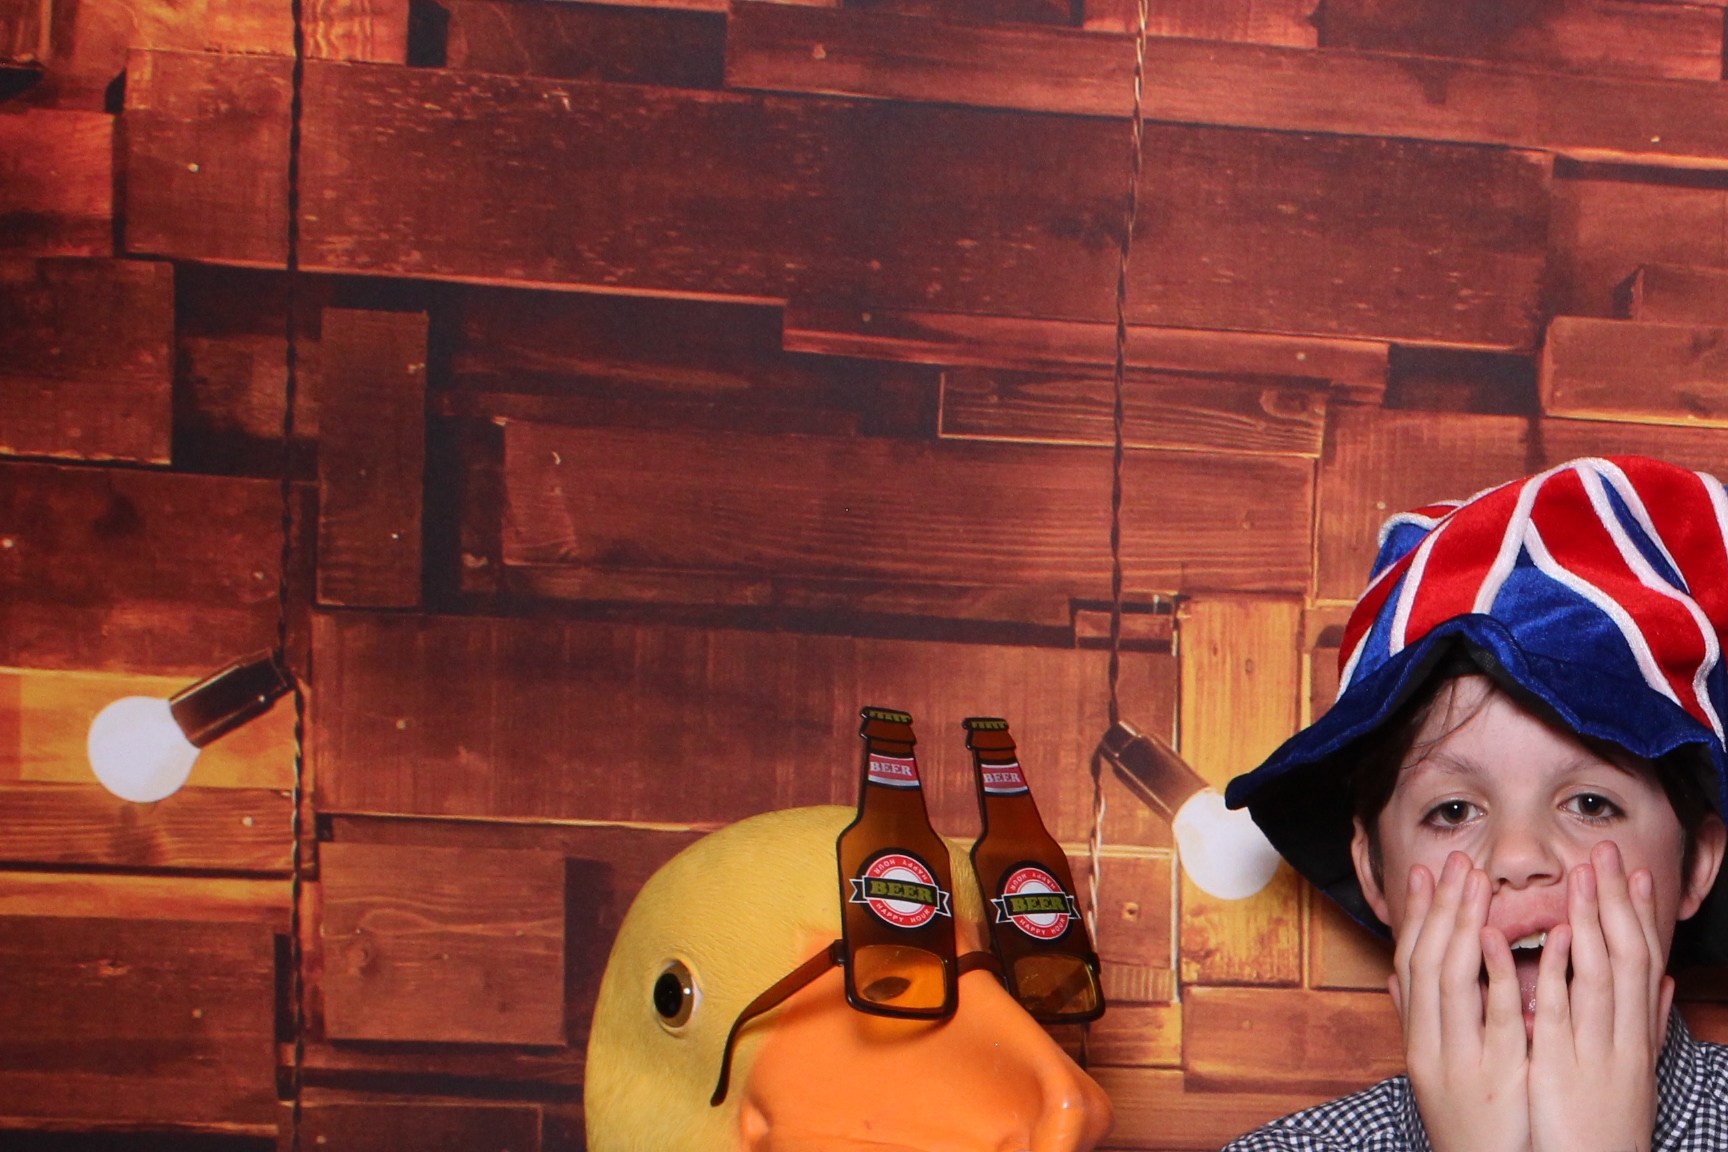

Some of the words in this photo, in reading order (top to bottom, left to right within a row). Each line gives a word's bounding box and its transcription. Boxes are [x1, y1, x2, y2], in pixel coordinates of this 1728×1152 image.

[870, 761, 913, 777] BEER
[983, 772, 1021, 784] BEER
[873, 859, 896, 875] HOUR
[902, 859, 929, 880] HAPPY
[870, 880, 934, 903] BEER
[875, 902, 905, 922] HAPPY
[910, 908, 931, 923] HOUR
[1010, 896, 1066, 913] BEER
[1019, 919, 1046, 935] HAPPY
[1050, 917, 1066, 935] HOUR
